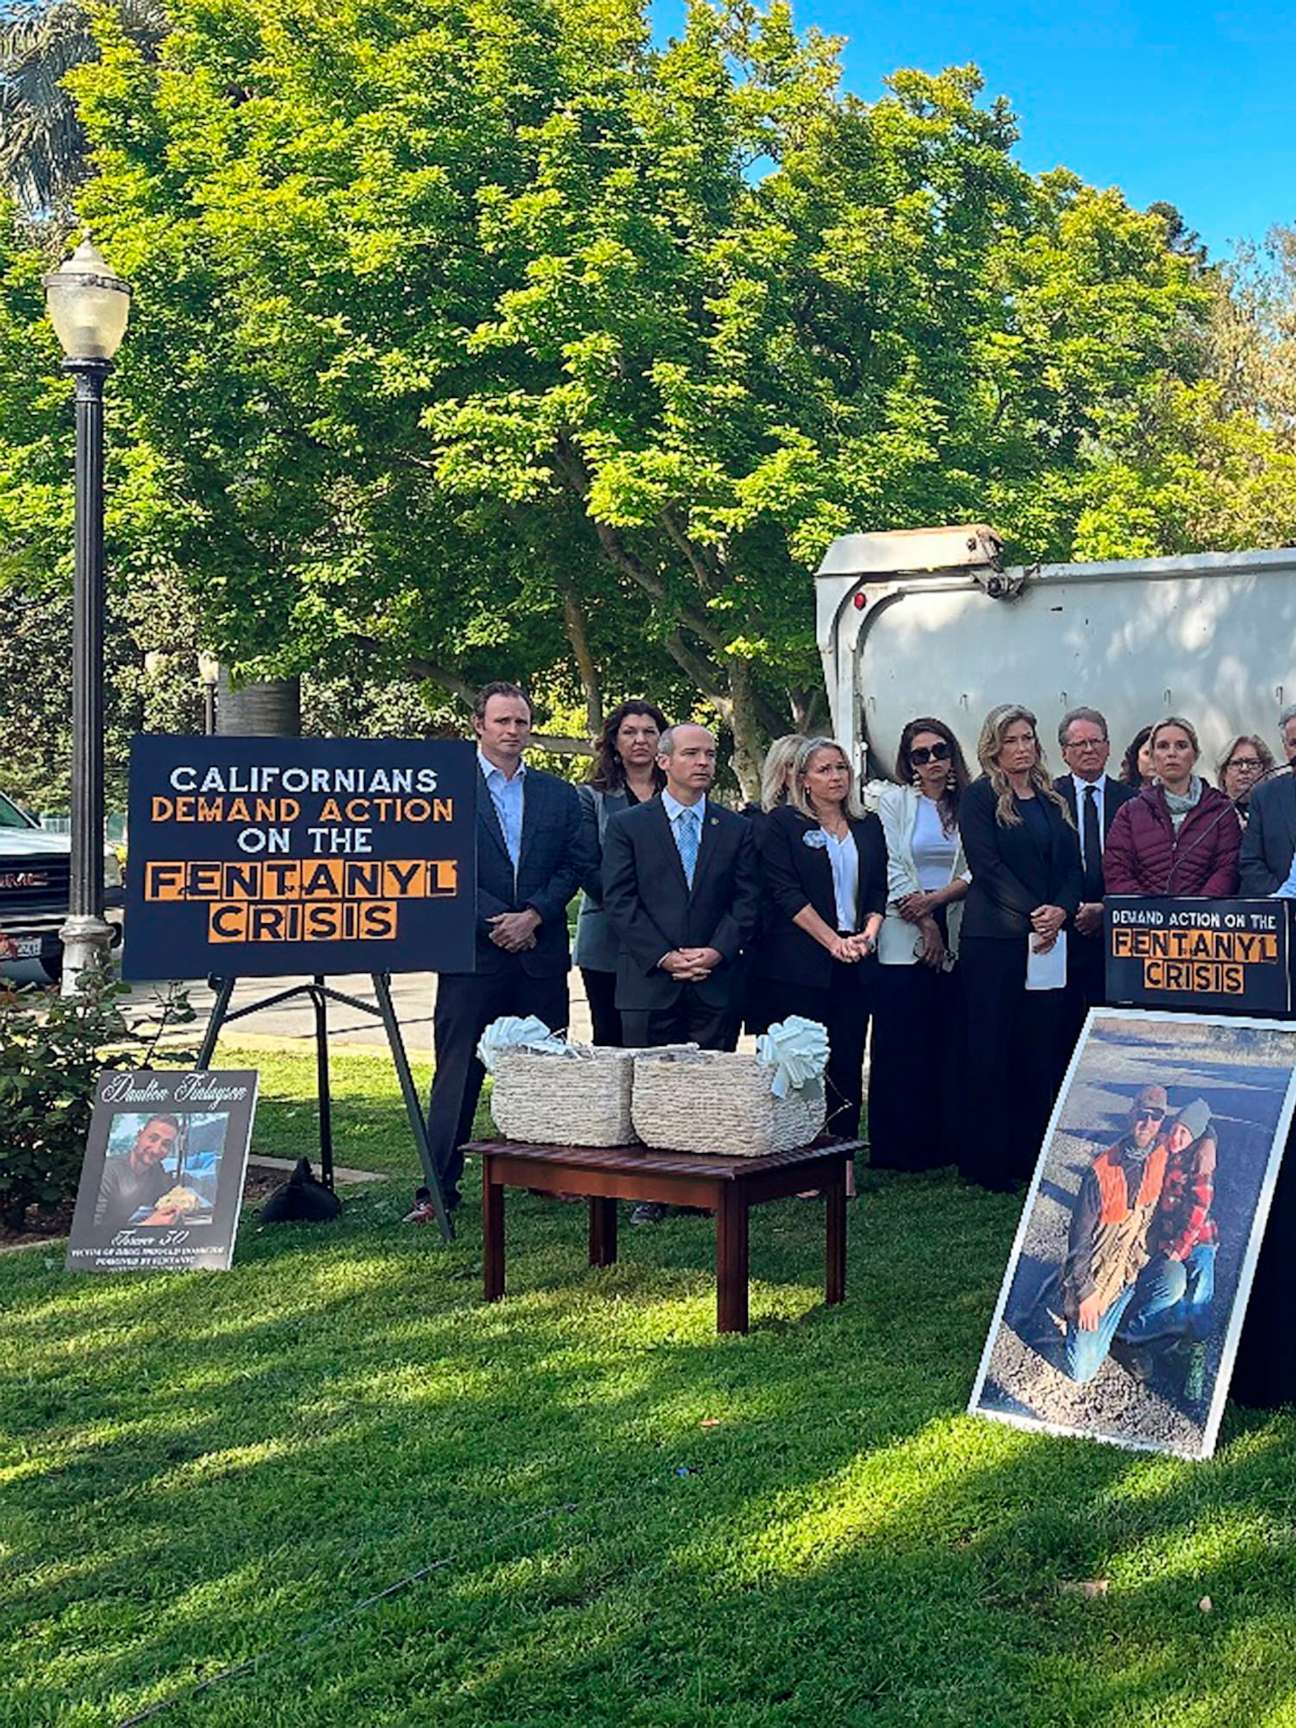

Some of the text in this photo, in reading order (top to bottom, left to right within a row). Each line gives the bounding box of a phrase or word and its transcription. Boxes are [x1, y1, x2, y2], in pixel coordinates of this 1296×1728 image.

[169, 766, 439, 793] CALIFORNIANS
[151, 795, 454, 822] DEMAND ACTION
[237, 828, 373, 854] ON THE
[150, 863, 457, 898] FENTANYL
[212, 904, 392, 940] CRISIS
[1112, 910, 1277, 930] DEMAND ACTION ON THE
[1114, 930, 1277, 963] FENTANYL
[1146, 962, 1242, 992] CRISIS
